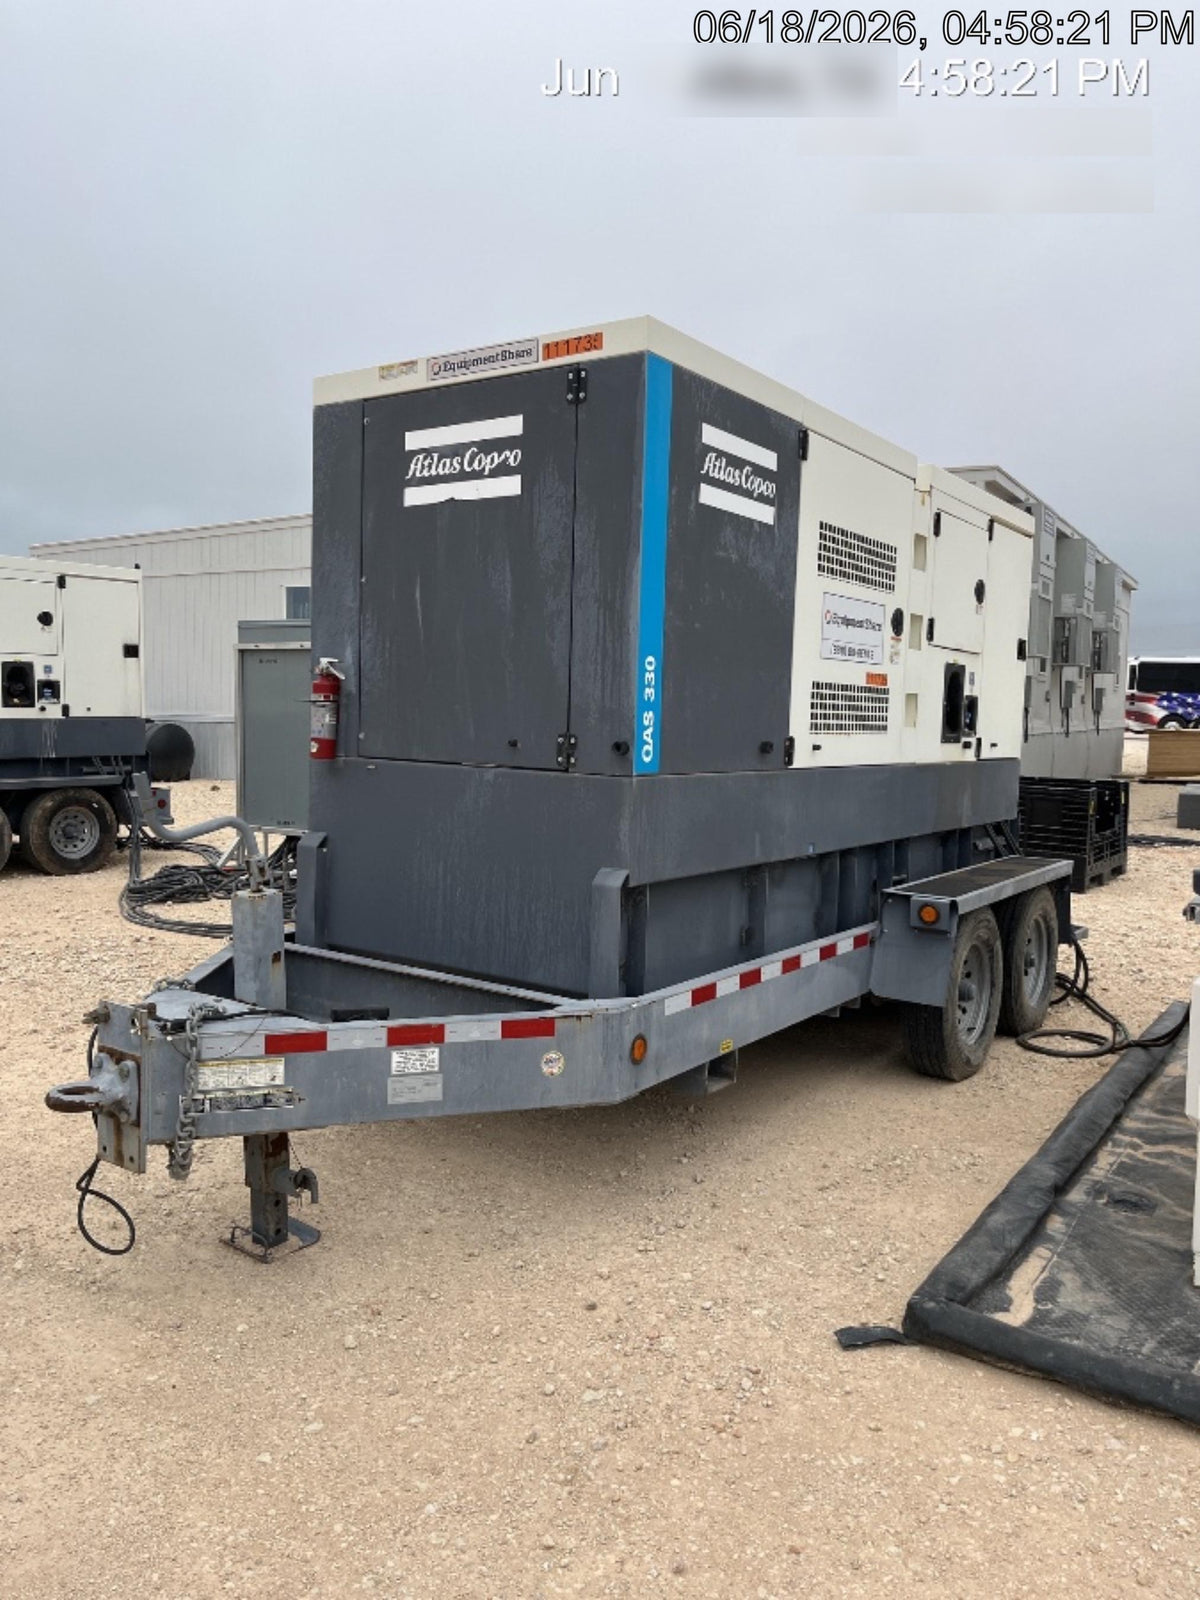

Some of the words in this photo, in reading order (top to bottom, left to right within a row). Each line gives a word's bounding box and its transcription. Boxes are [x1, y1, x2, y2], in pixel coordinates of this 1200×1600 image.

[405, 452, 461, 479] Atlas
[700, 452, 740, 486] Atlas
[644, 655, 656, 702] 330
[642, 711, 654, 763] QAS
